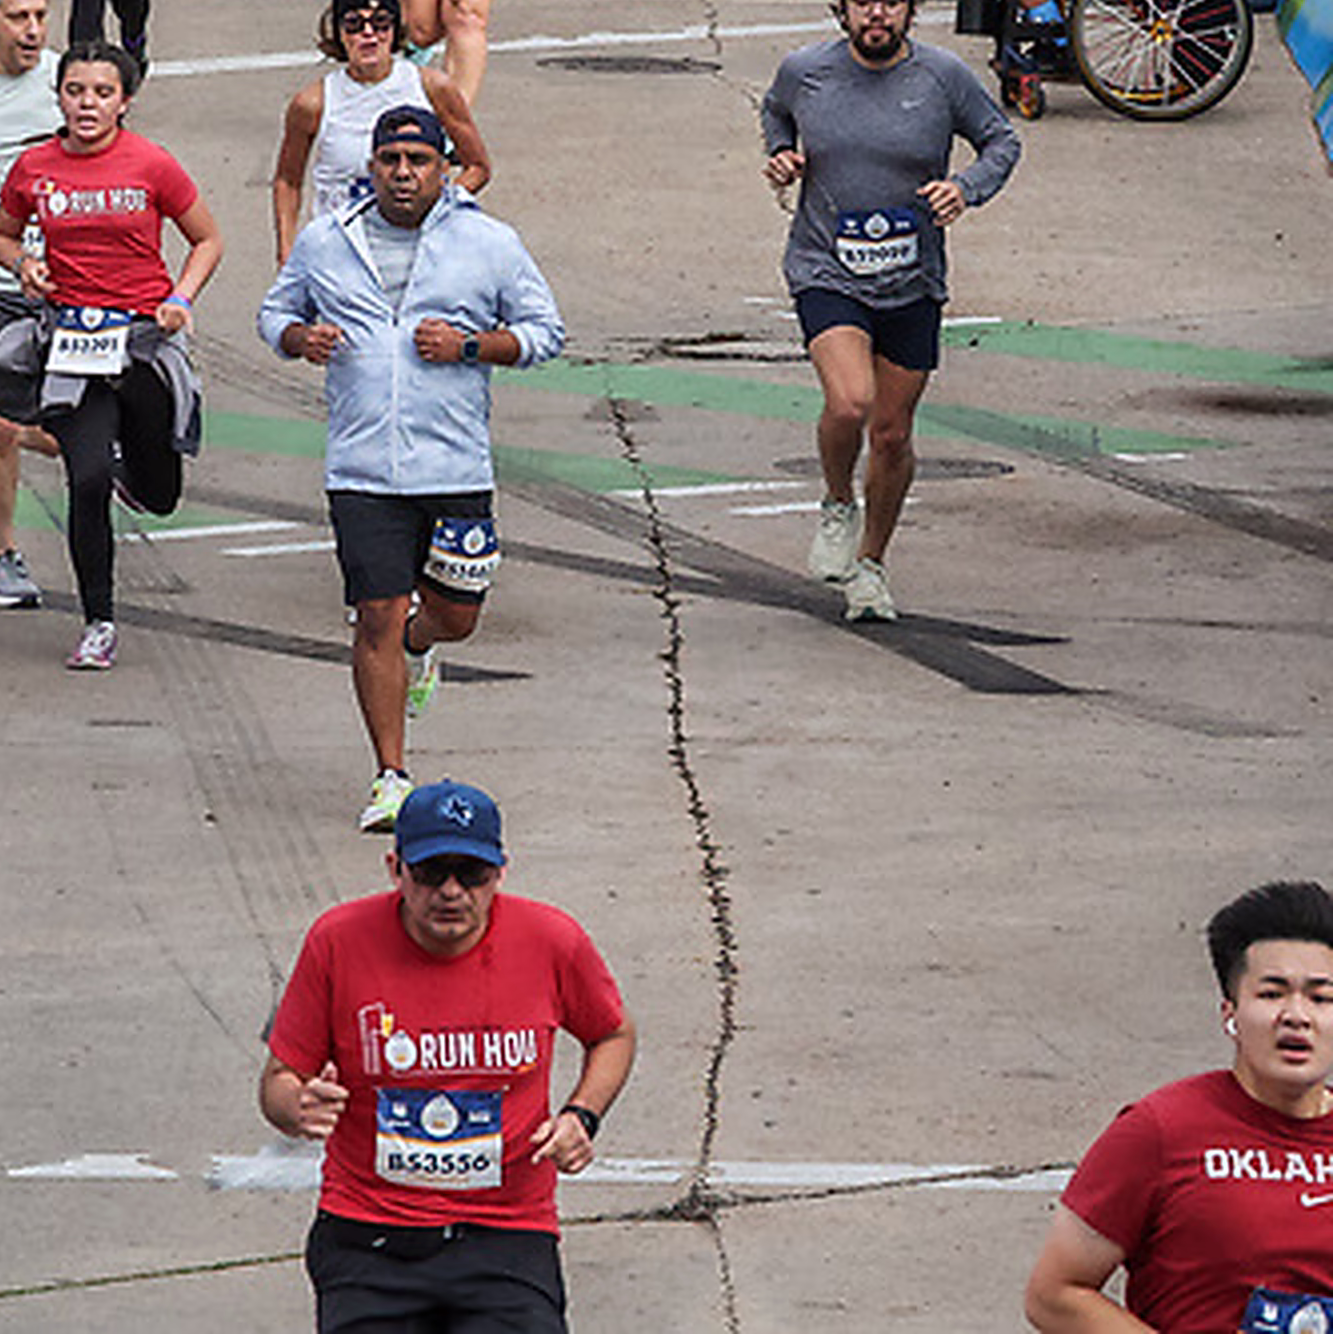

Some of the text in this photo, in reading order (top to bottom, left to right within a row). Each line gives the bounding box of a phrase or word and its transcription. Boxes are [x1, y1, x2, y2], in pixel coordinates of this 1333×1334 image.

[420, 1029, 539, 1068] RUN HOU
[387, 1151, 491, 1173] B53556
